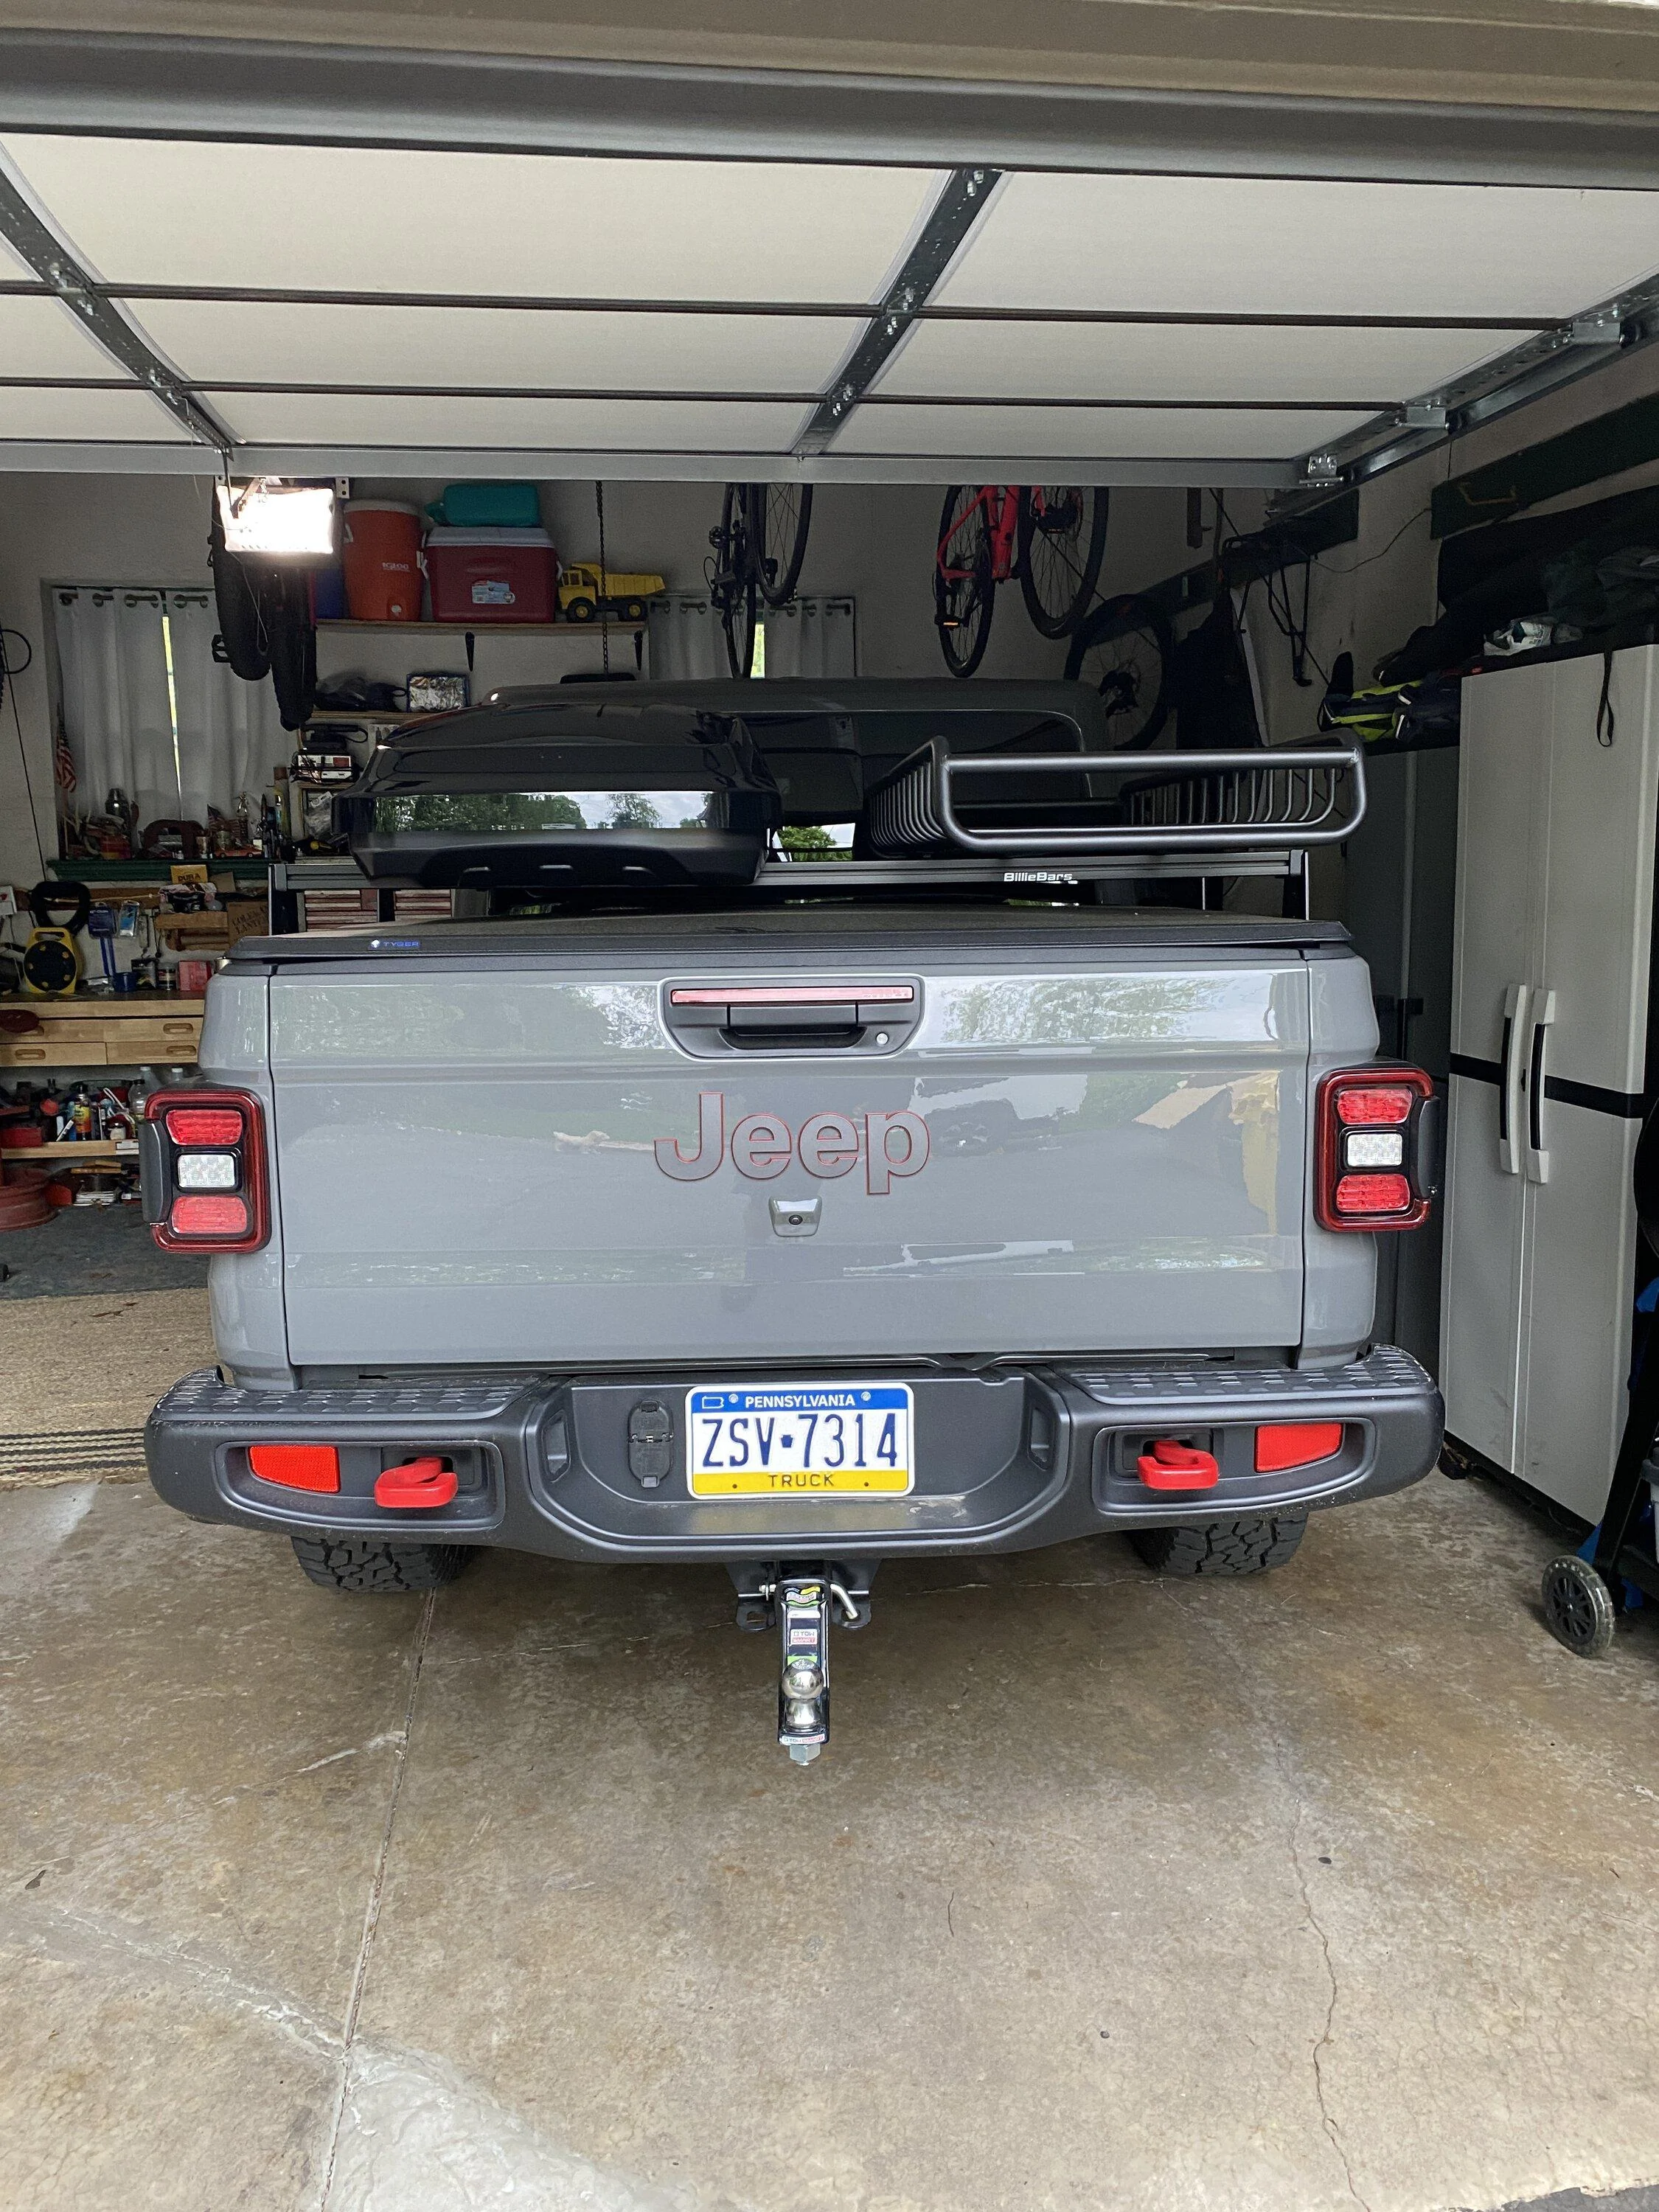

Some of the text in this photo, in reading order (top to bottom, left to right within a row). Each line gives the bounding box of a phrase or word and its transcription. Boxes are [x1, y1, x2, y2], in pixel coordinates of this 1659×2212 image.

[1004, 872, 1073, 882] BillieBars
[654, 1091, 930, 1194] Jeep
[745, 1394, 855, 1409] PENNSYLVANIA
[768, 1473, 835, 1487] TRUCK
